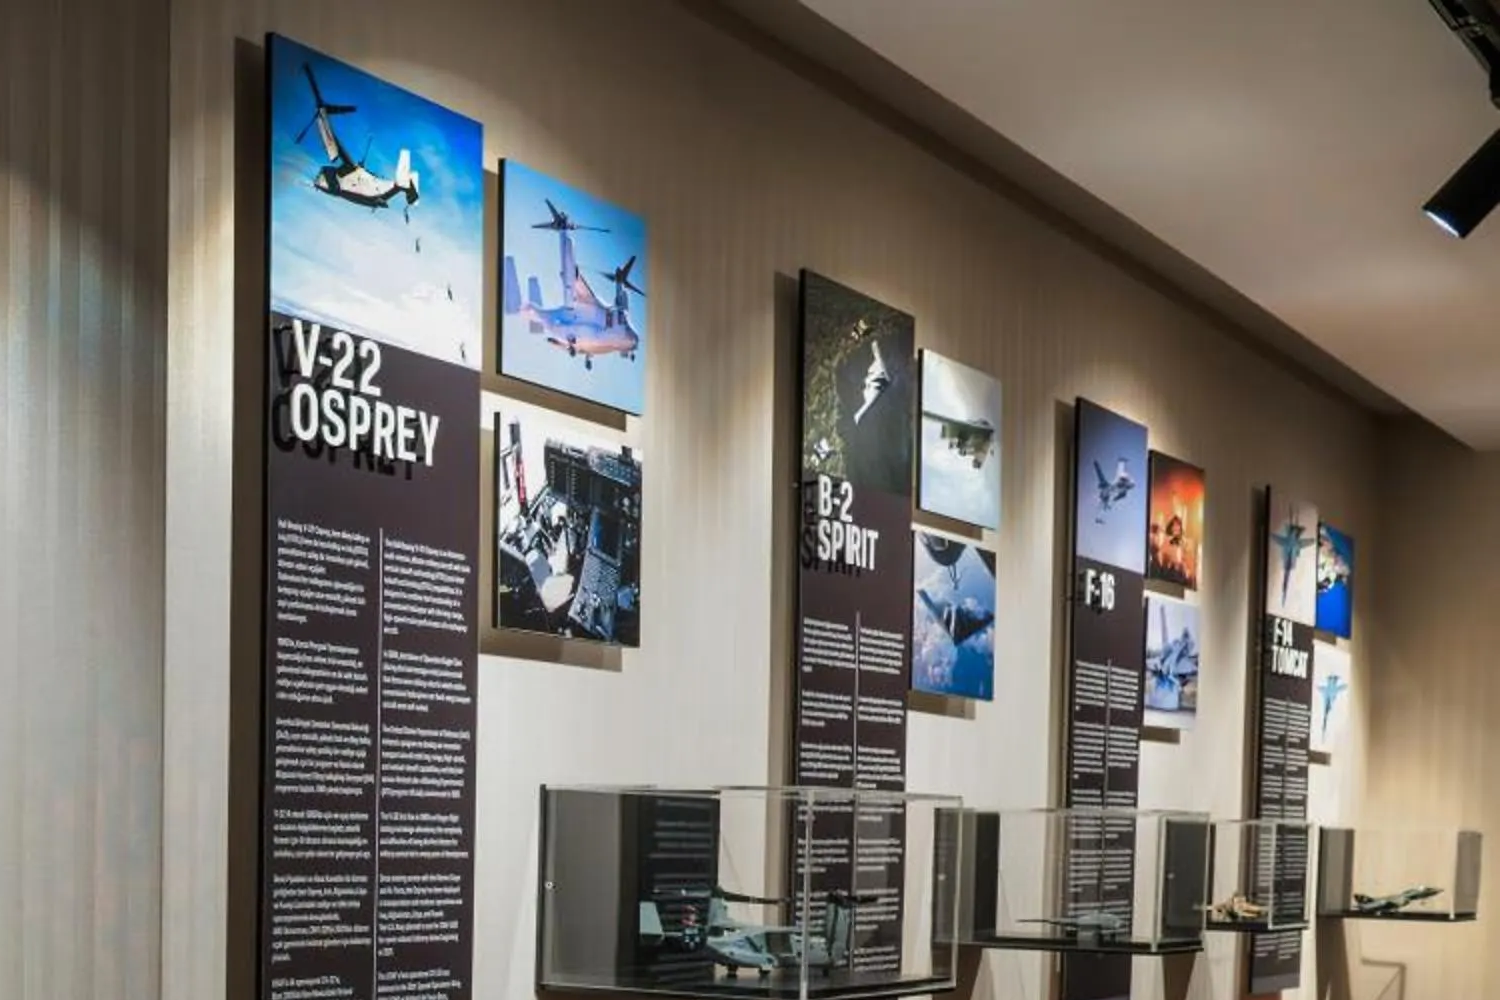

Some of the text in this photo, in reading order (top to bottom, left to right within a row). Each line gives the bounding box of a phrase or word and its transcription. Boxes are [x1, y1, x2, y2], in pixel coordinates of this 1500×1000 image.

[292, 318, 382, 397] V-22
[289, 382, 441, 467] OSPREY
[817, 473, 854, 523] B-2
[816, 518, 880, 572] SPIRIT
[1084, 568, 1116, 611] F-16
